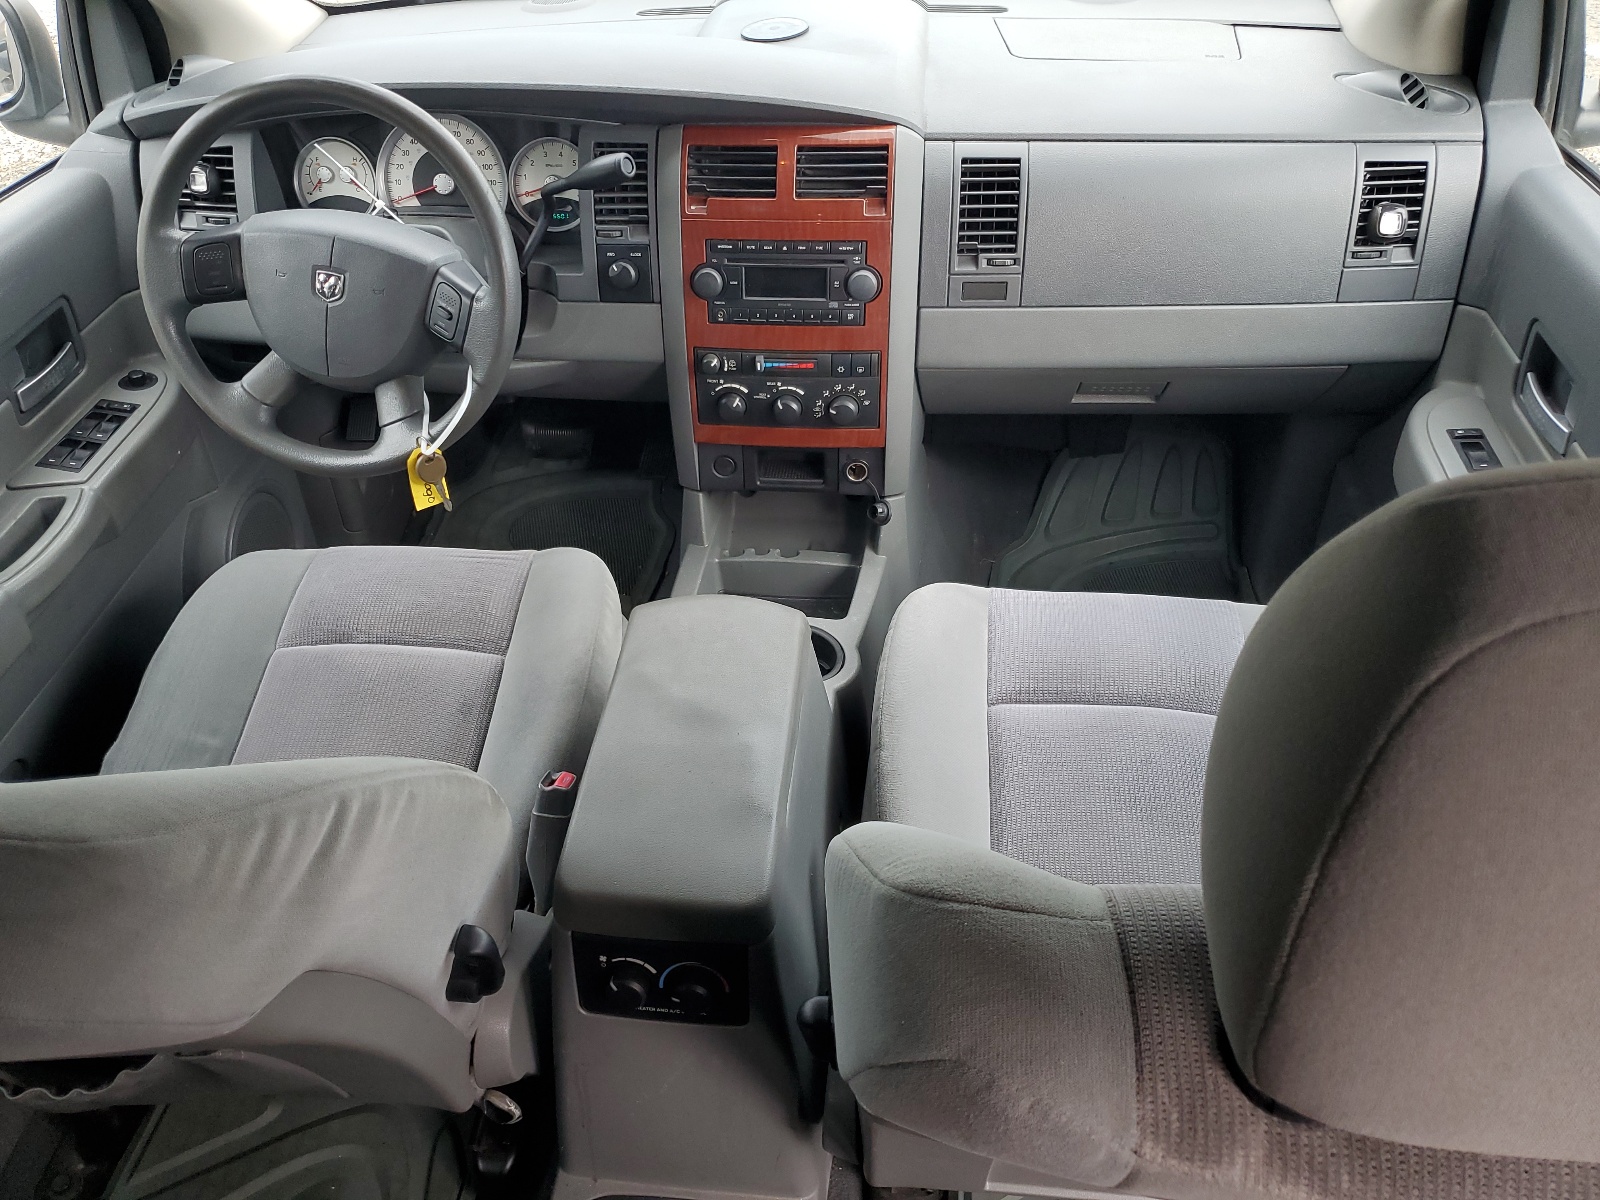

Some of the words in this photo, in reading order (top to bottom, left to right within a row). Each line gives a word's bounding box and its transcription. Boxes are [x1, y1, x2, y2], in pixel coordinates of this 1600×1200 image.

[481, 163, 494, 171] 100
[530, 159, 535, 167] 2
[572, 159, 577, 167] 5
